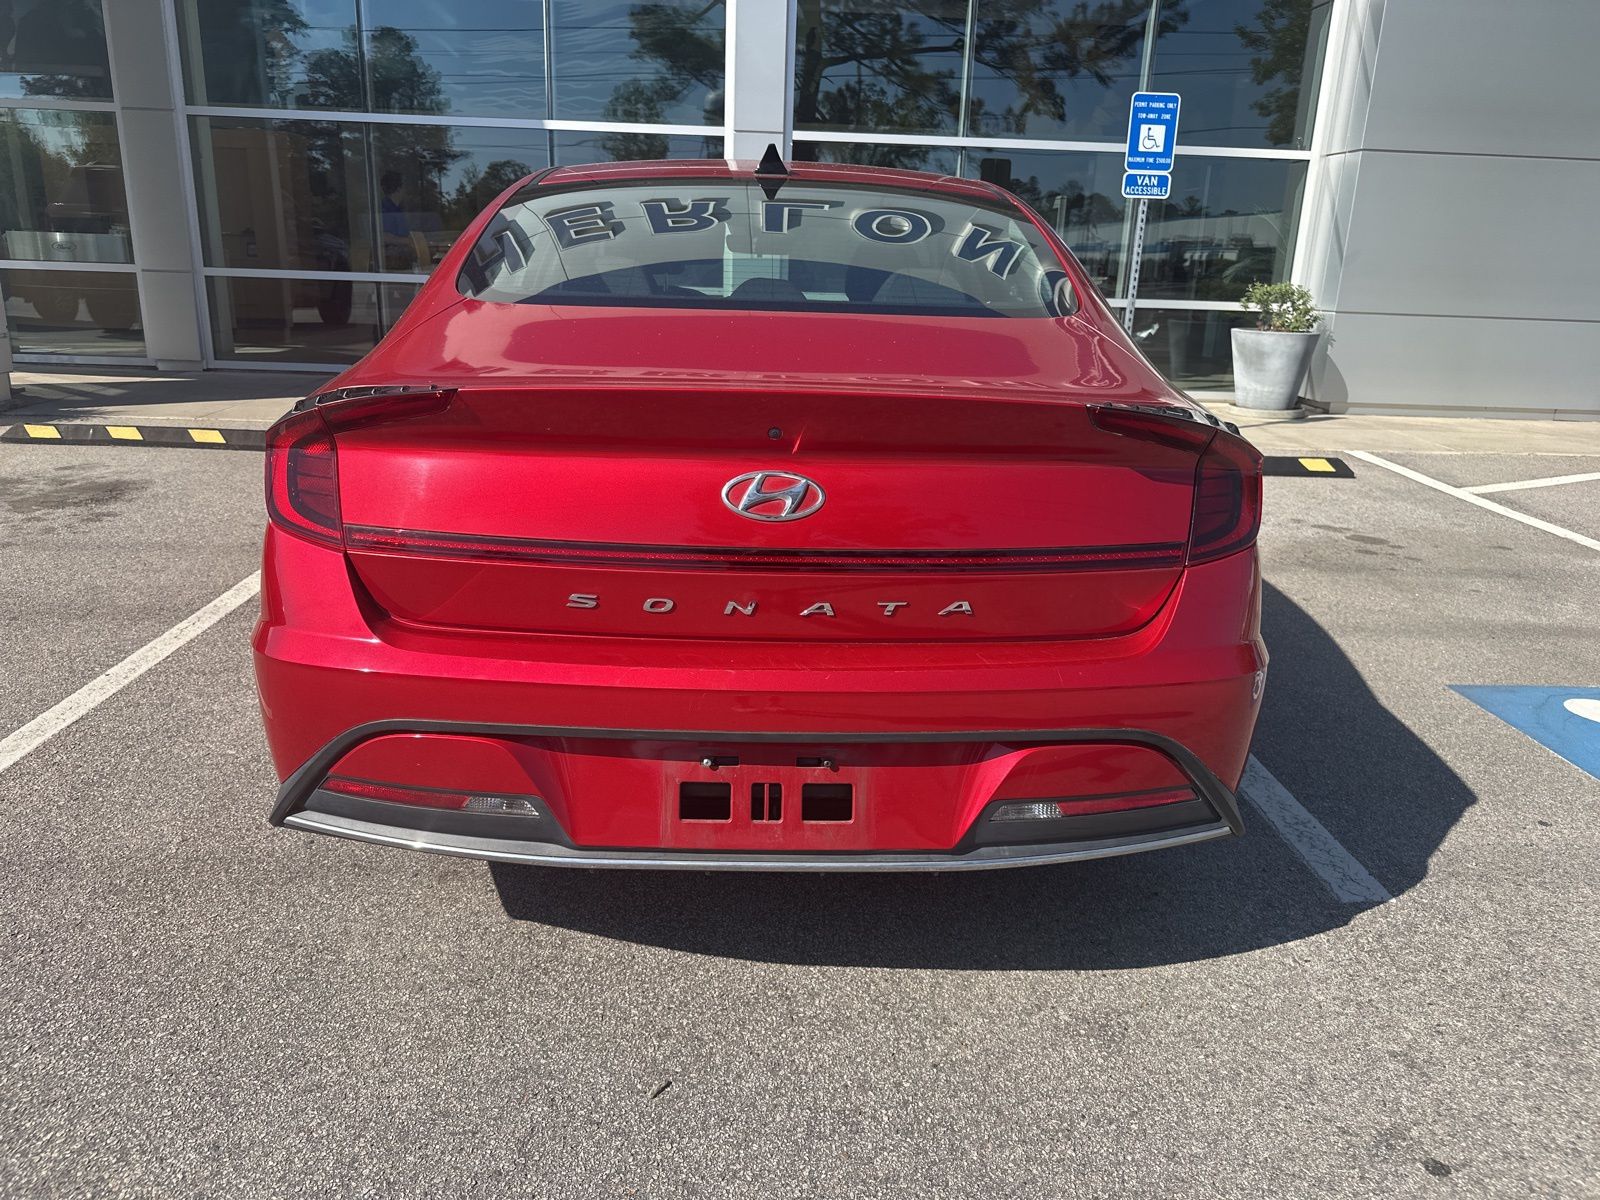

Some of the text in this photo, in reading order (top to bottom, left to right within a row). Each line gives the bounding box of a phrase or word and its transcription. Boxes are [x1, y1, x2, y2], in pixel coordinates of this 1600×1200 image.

[1136, 175, 1159, 186] VAN
[1125, 186, 1167, 195] ACCESSIBLE
[566, 593, 974, 617] SONATA
